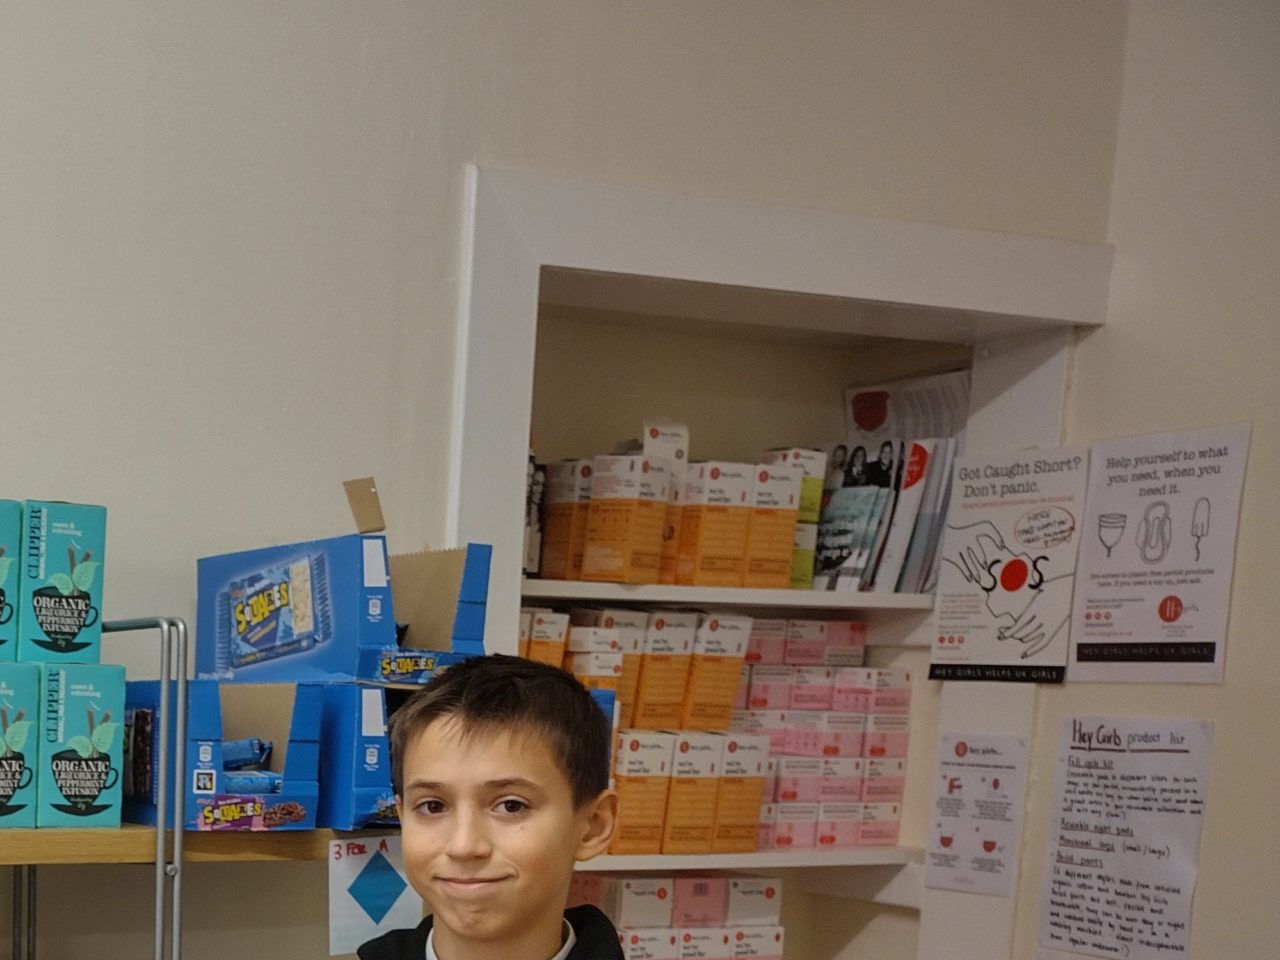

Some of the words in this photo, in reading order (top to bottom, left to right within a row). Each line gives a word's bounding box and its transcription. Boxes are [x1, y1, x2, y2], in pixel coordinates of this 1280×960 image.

[1106, 456, 1131, 469] Help
[1133, 451, 1181, 468] yourself
[1183, 450, 1195, 460] to
[1198, 446, 1228, 459] what
[959, 467, 980, 481] Got
[983, 461, 1030, 479] Caught
[1034, 456, 1081, 474] Short?
[1107, 474, 1128, 486] you
[1131, 470, 1160, 482] need,
[1164, 466, 1195, 478] when
[1197, 465, 1221, 478] you
[964, 483, 997, 498] Don't
[1139, 485, 1166, 496] need
[33, 596, 90, 610] ORGANIC
[1072, 718, 1092, 750] Hey
[1127, 732, 1160, 749] product
[52, 760, 110, 772] ORGANIC
[333, 844, 342, 860] 3
[379, 839, 390, 853] A
